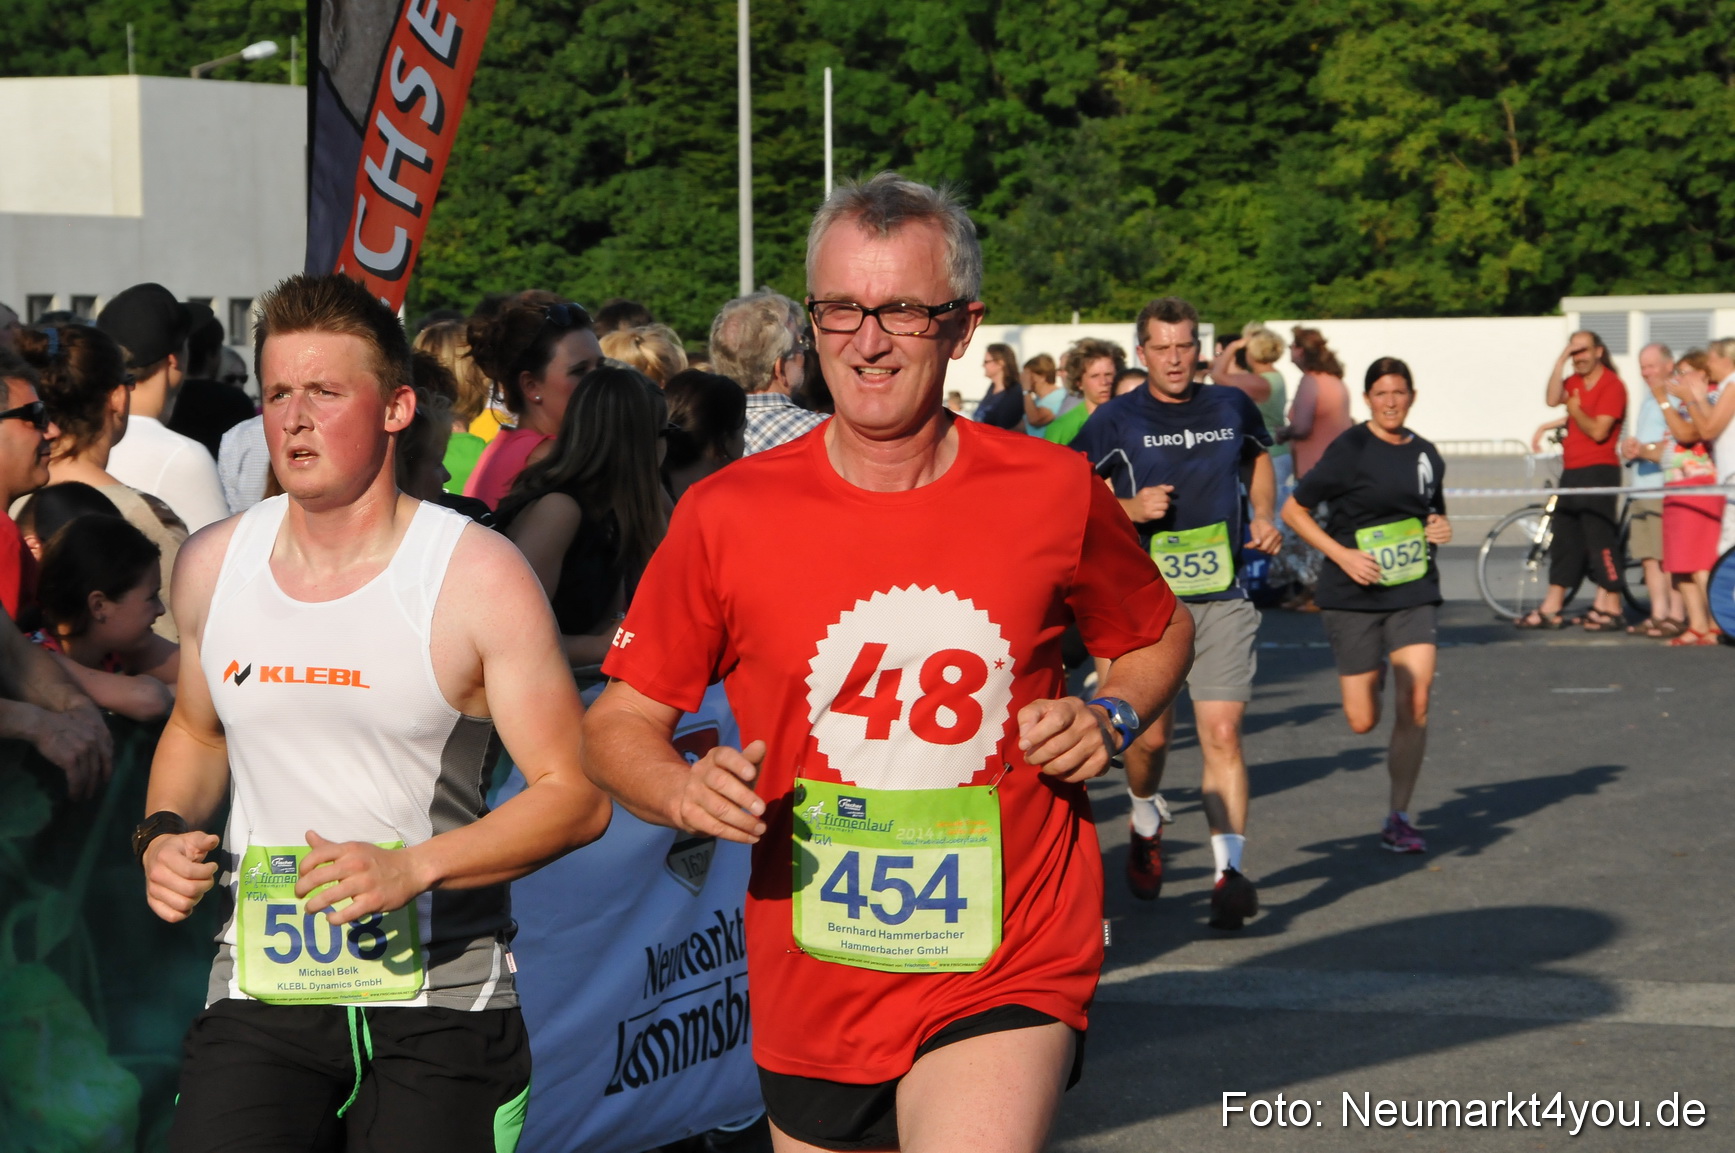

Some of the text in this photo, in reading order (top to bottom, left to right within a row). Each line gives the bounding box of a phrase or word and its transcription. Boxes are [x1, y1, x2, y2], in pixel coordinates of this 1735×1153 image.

[350, 0, 460, 280] CHSE
[1163, 550, 1219, 578] 353
[260, 666, 370, 688] KLEBL
[824, 812, 894, 832] firmenlauf
[261, 872, 298, 884] firmen
[820, 851, 968, 925] 454
[263, 904, 388, 964] 508
[828, 922, 964, 940] Bernhard Hammerbacher
[841, 940, 914, 955] Hammerbacher
[918, 942, 949, 954] GmbH
[299, 966, 359, 976] Michael Belk
[278, 978, 382, 992] KLEBL Dynamics GmbH
